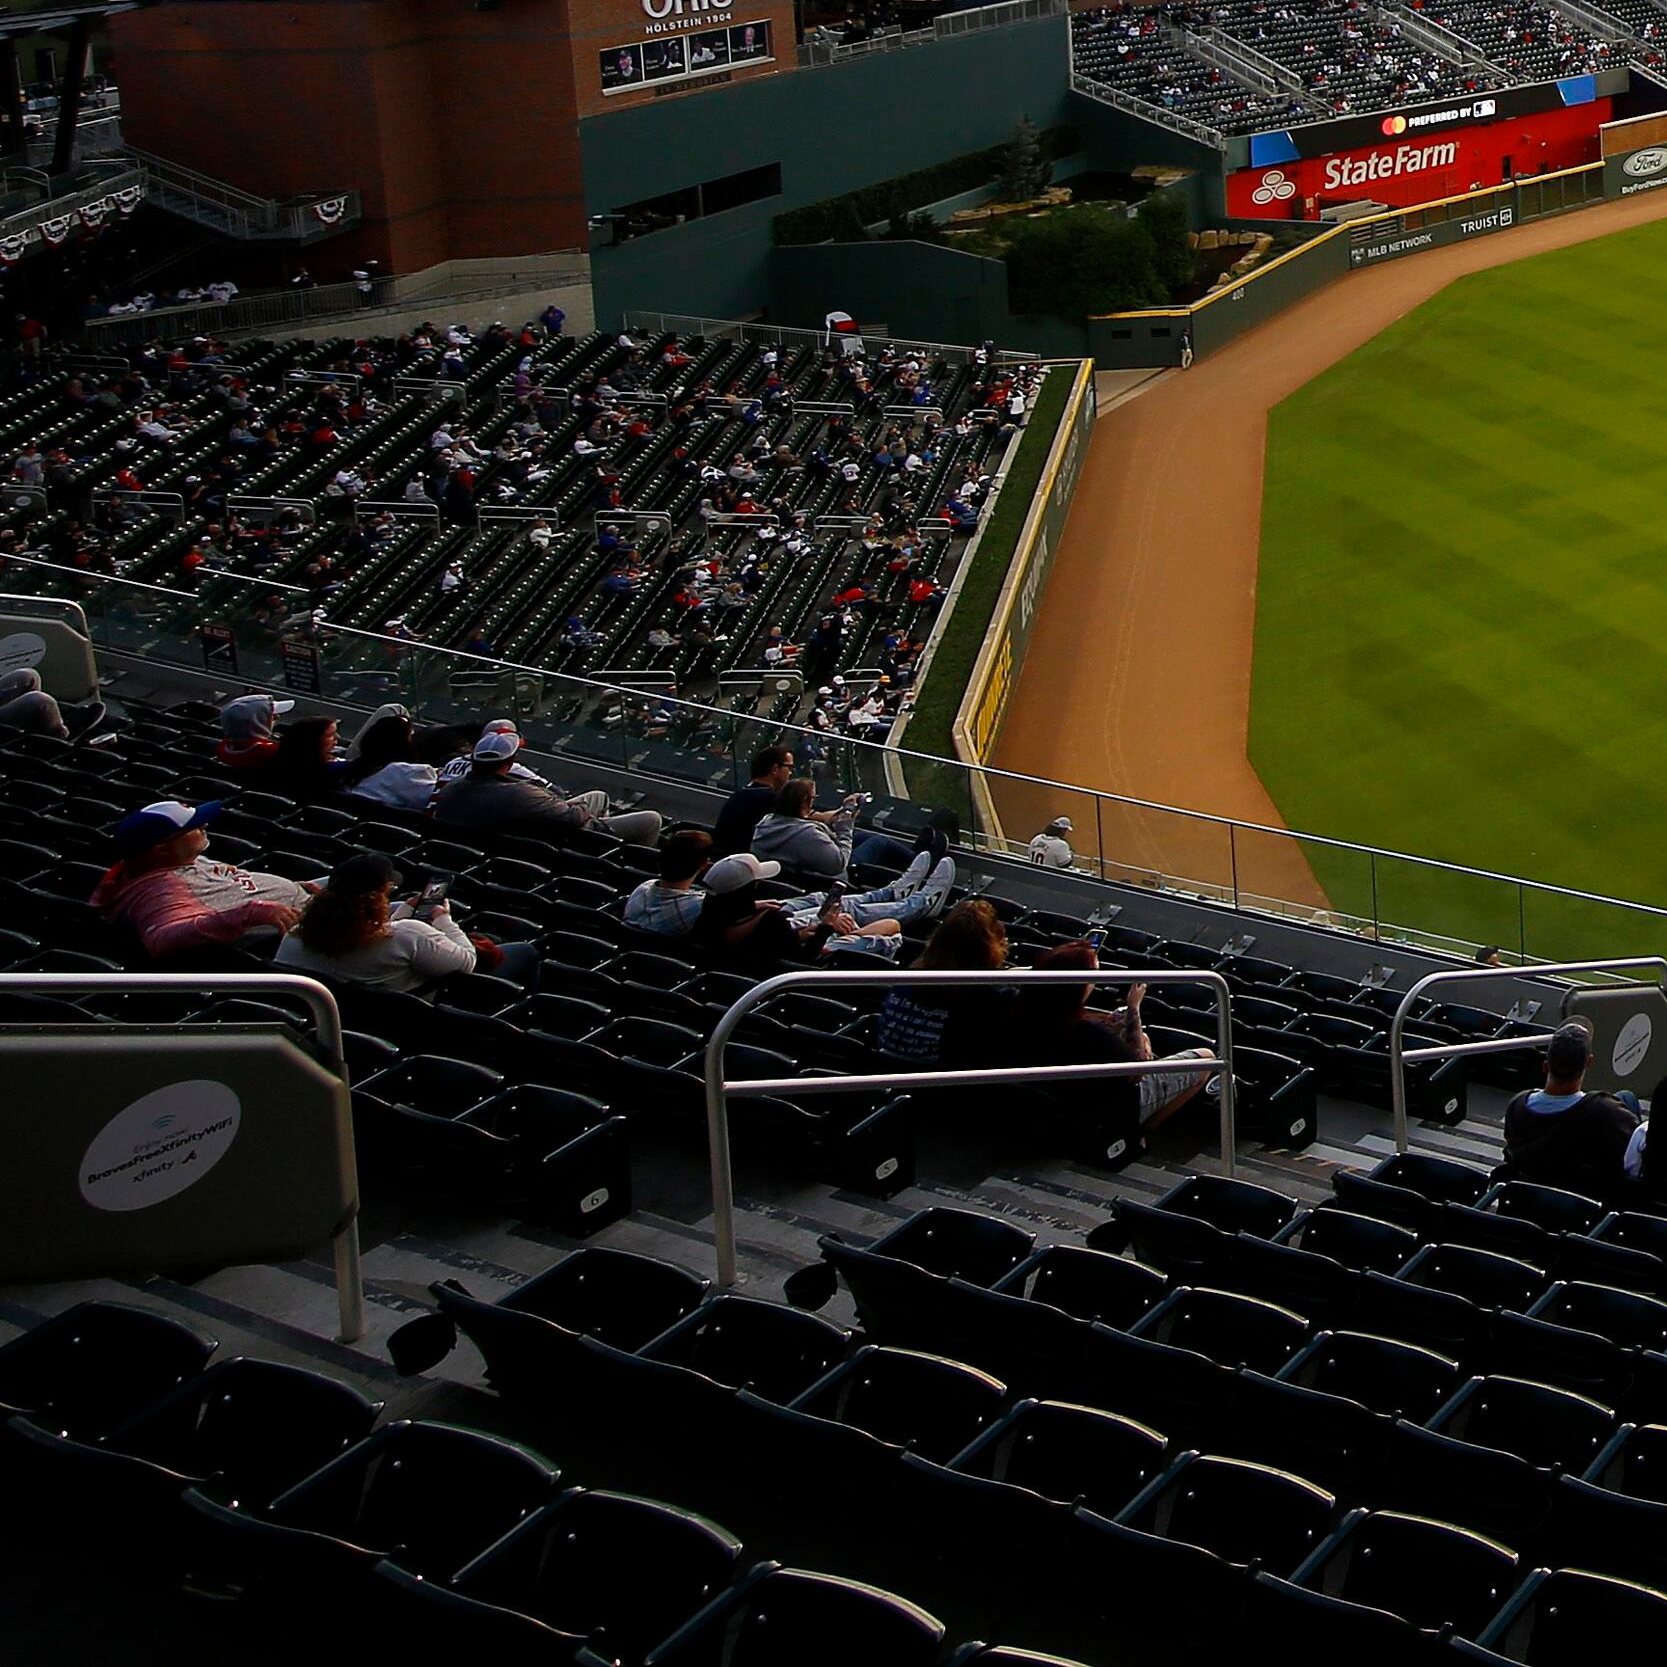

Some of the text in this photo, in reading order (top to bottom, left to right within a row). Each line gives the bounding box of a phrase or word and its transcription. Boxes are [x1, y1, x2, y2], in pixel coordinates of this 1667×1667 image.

[706, 12, 732, 24] 1904
[1408, 107, 1472, 128] PREFERRED BY
[1633, 153, 1663, 172] Ford
[1460, 214, 1499, 234] TRUIST
[1367, 234, 1432, 258] MLB NETWORK
[87, 1117, 233, 1184] BravesFreeXfinityWiFi
[132, 1159, 175, 1184] xfinity
[591, 1197, 599, 1206] 6
